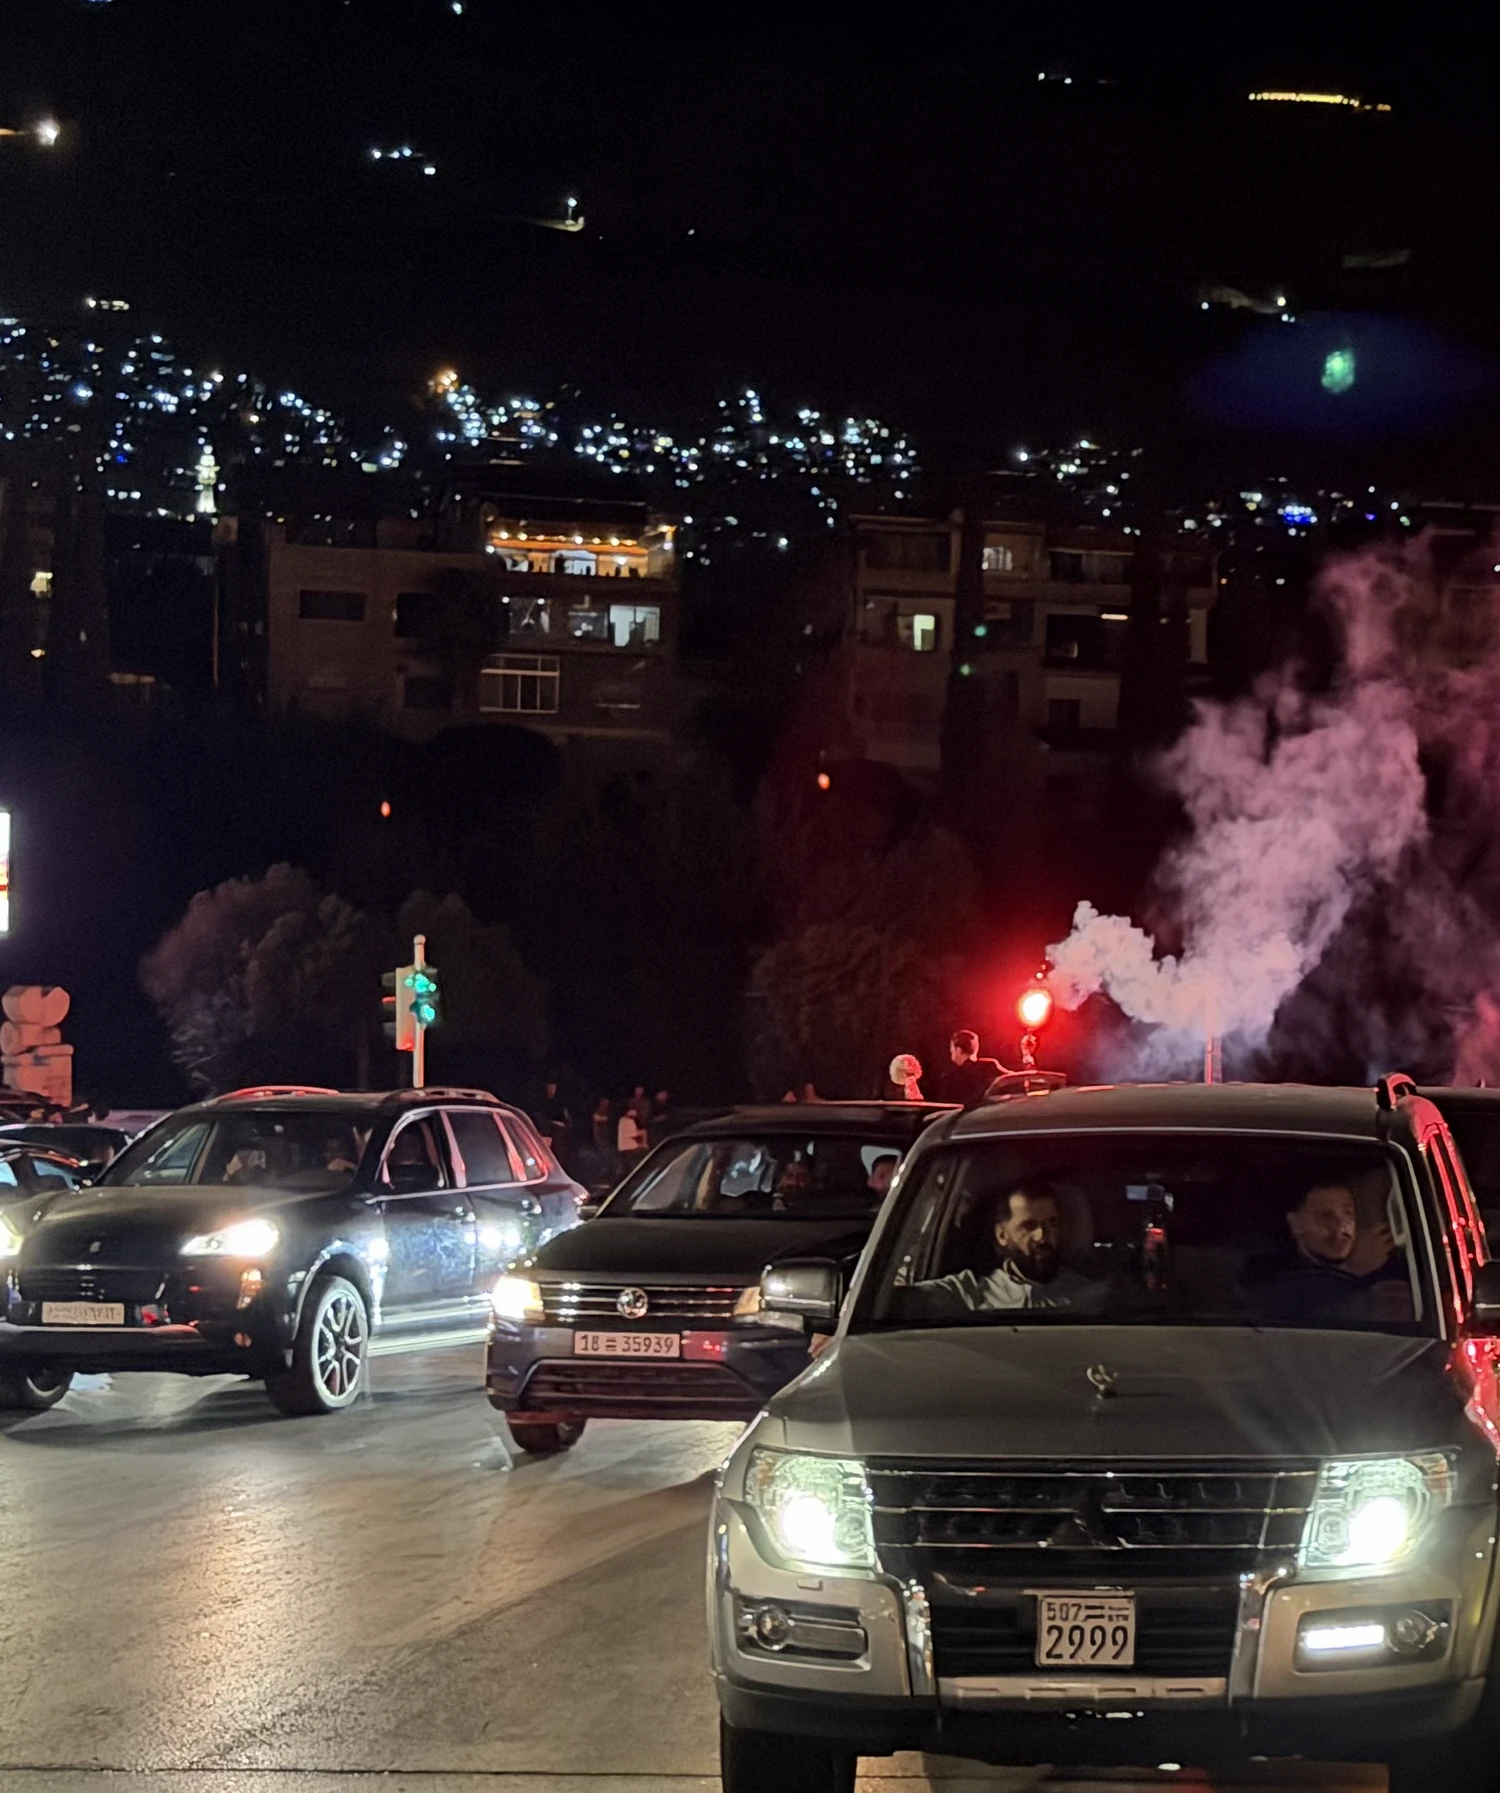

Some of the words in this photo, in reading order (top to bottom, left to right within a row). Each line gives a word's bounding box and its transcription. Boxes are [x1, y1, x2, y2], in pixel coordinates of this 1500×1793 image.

[621, 1335, 674, 1353] 35939
[1046, 1602, 1082, 1622] 507
[1045, 1624, 1129, 1660] 2999
